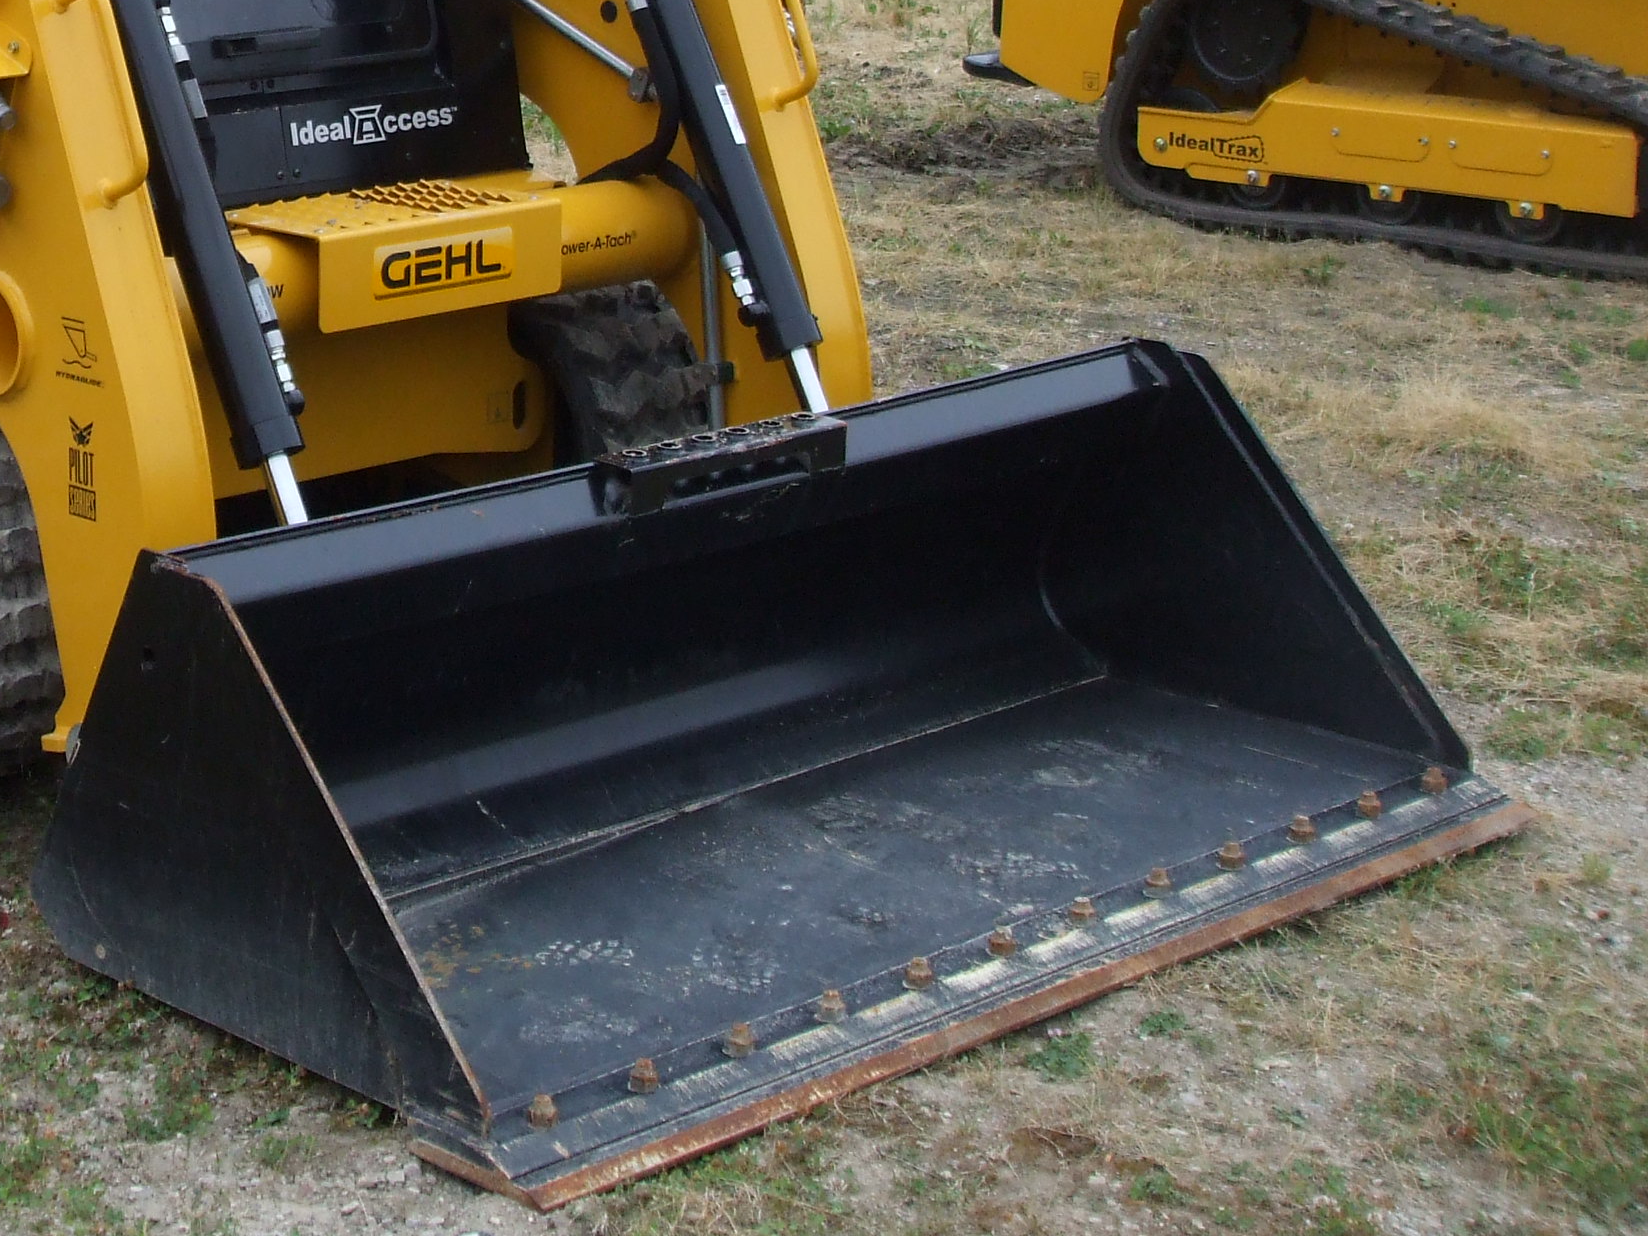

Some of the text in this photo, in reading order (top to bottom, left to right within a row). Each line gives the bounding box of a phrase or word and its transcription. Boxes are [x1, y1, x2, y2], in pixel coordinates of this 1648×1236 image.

[560, 231, 632, 256] ower-A-Tach
[380, 239, 502, 290] GEHL
[68, 447, 95, 487] PILOT
